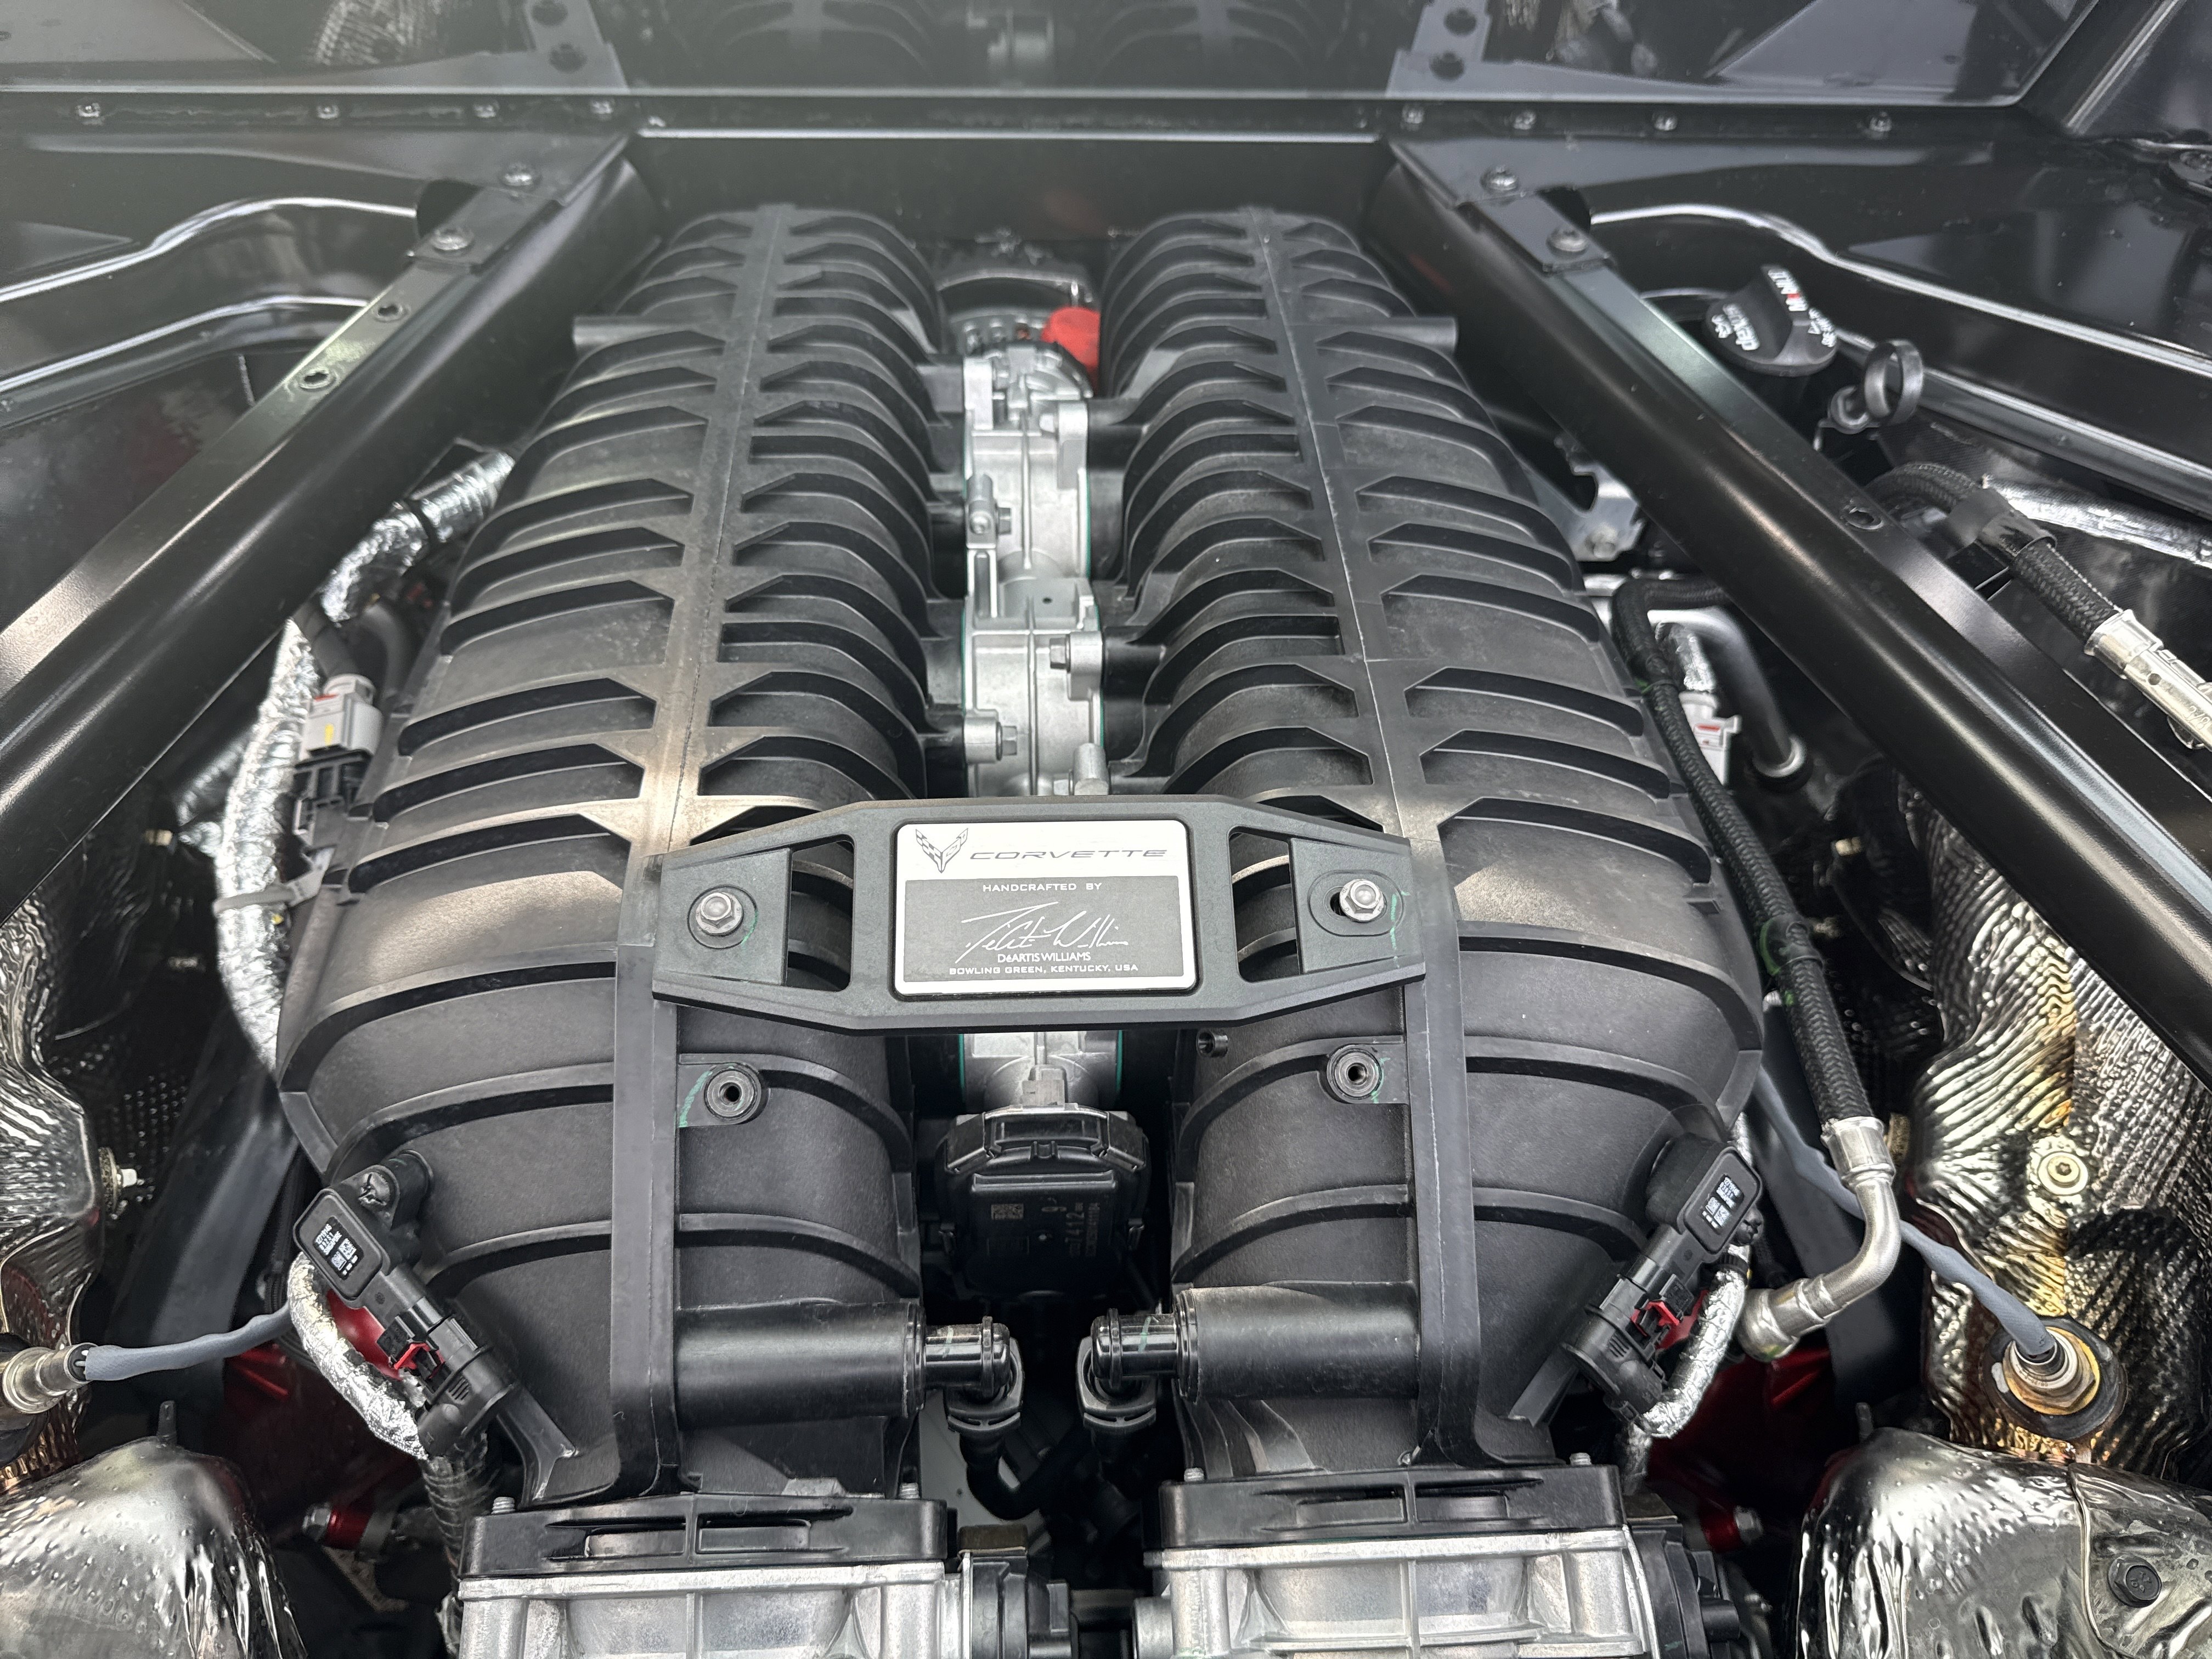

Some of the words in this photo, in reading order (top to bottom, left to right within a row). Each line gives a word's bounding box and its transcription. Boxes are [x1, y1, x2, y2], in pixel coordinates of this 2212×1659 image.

[970, 850, 1167, 860] CORVETTE
[983, 883, 1077, 893] HANDCRAFTED
[1085, 882, 1103, 891] BY
[1041, 951, 1092, 962] WILLIAMS
[949, 967, 1001, 975] BOWLING
[1005, 965, 1047, 974] GREEN,
[1050, 963, 1111, 973] KENTUCKY,
[1115, 963, 1139, 972] USA
